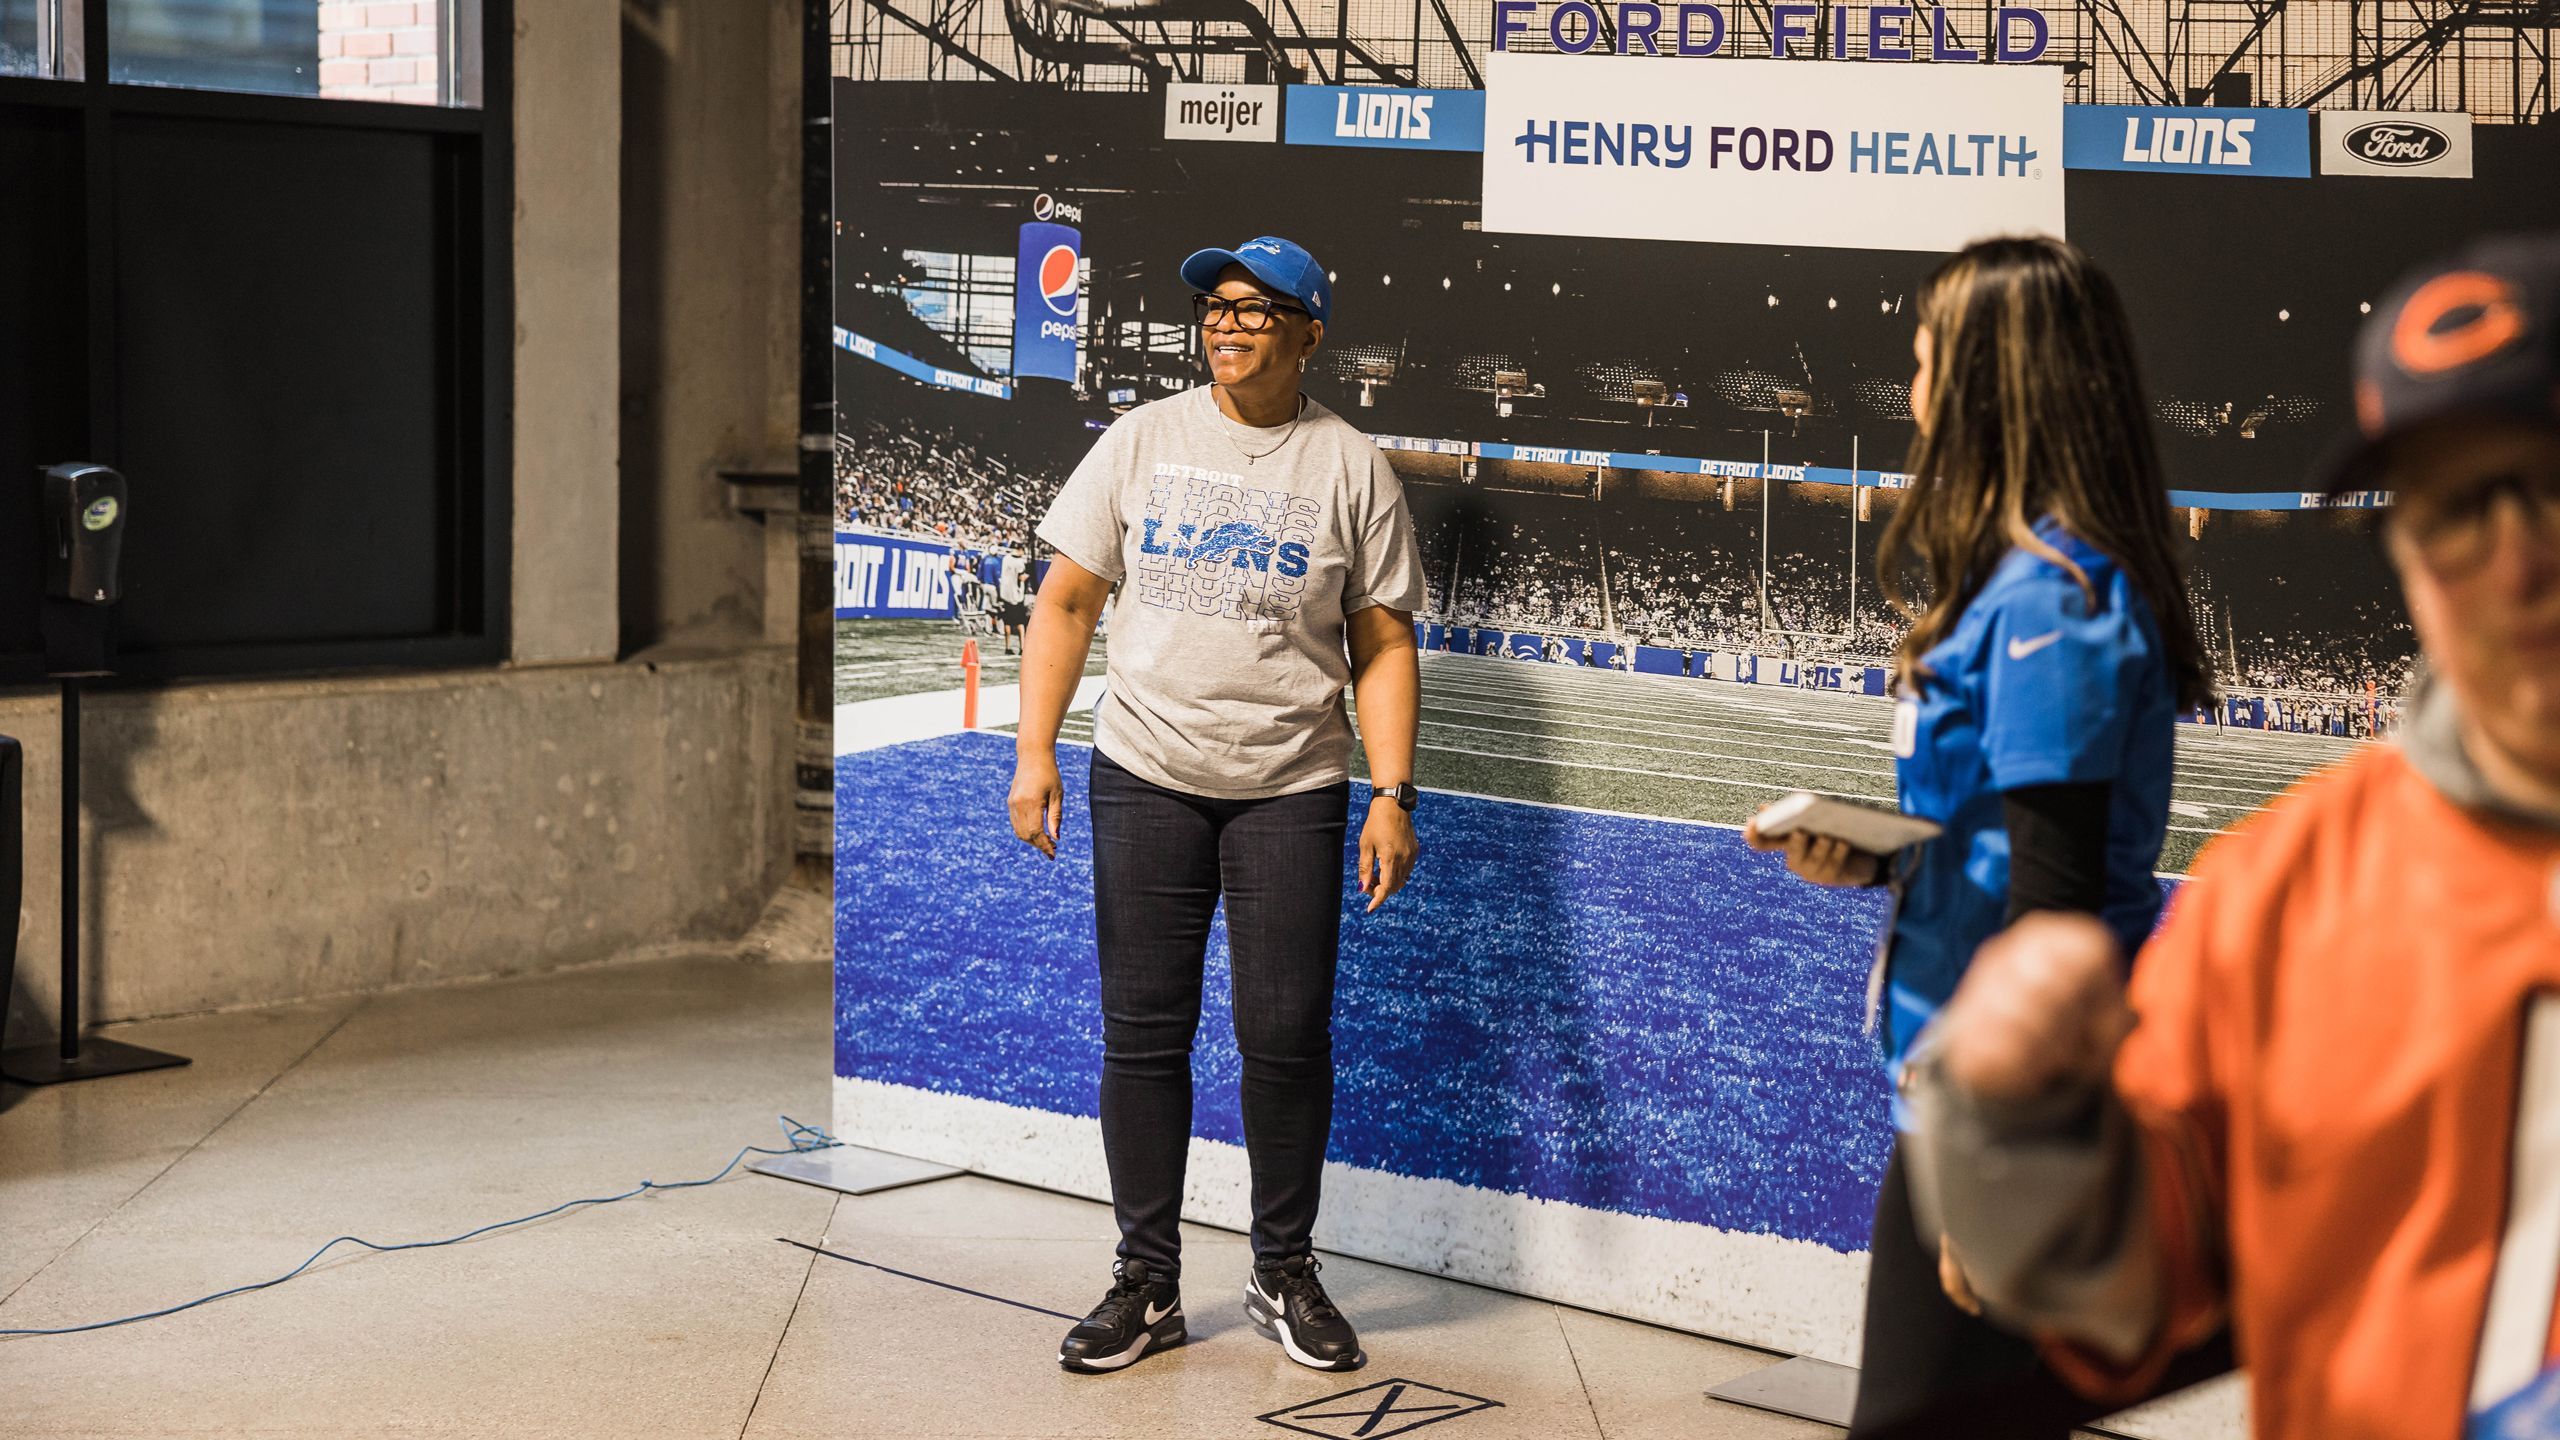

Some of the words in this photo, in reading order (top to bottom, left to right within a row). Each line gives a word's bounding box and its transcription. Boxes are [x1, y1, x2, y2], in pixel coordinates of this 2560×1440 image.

[1494, 0, 1726, 57] FORD
[1770, 4, 2049, 63] FIELD
[1179, 91, 1263, 134] meijer
[1335, 92, 1434, 140] LIONS
[1514, 119, 1693, 169] HENRY
[1709, 125, 1835, 172] FORD
[1849, 131, 2038, 178] HEALTH
[2122, 116, 2256, 167] LIONS
[2363, 127, 2431, 159] Ford
[1154, 463, 1245, 488] DETROIT
[1513, 445, 1568, 464] DETROIT
[1570, 450, 1611, 467] LIONS
[1699, 459, 1760, 479] DETROIT
[887, 548, 951, 610] LIONS
[1780, 662, 1844, 689] LINS
